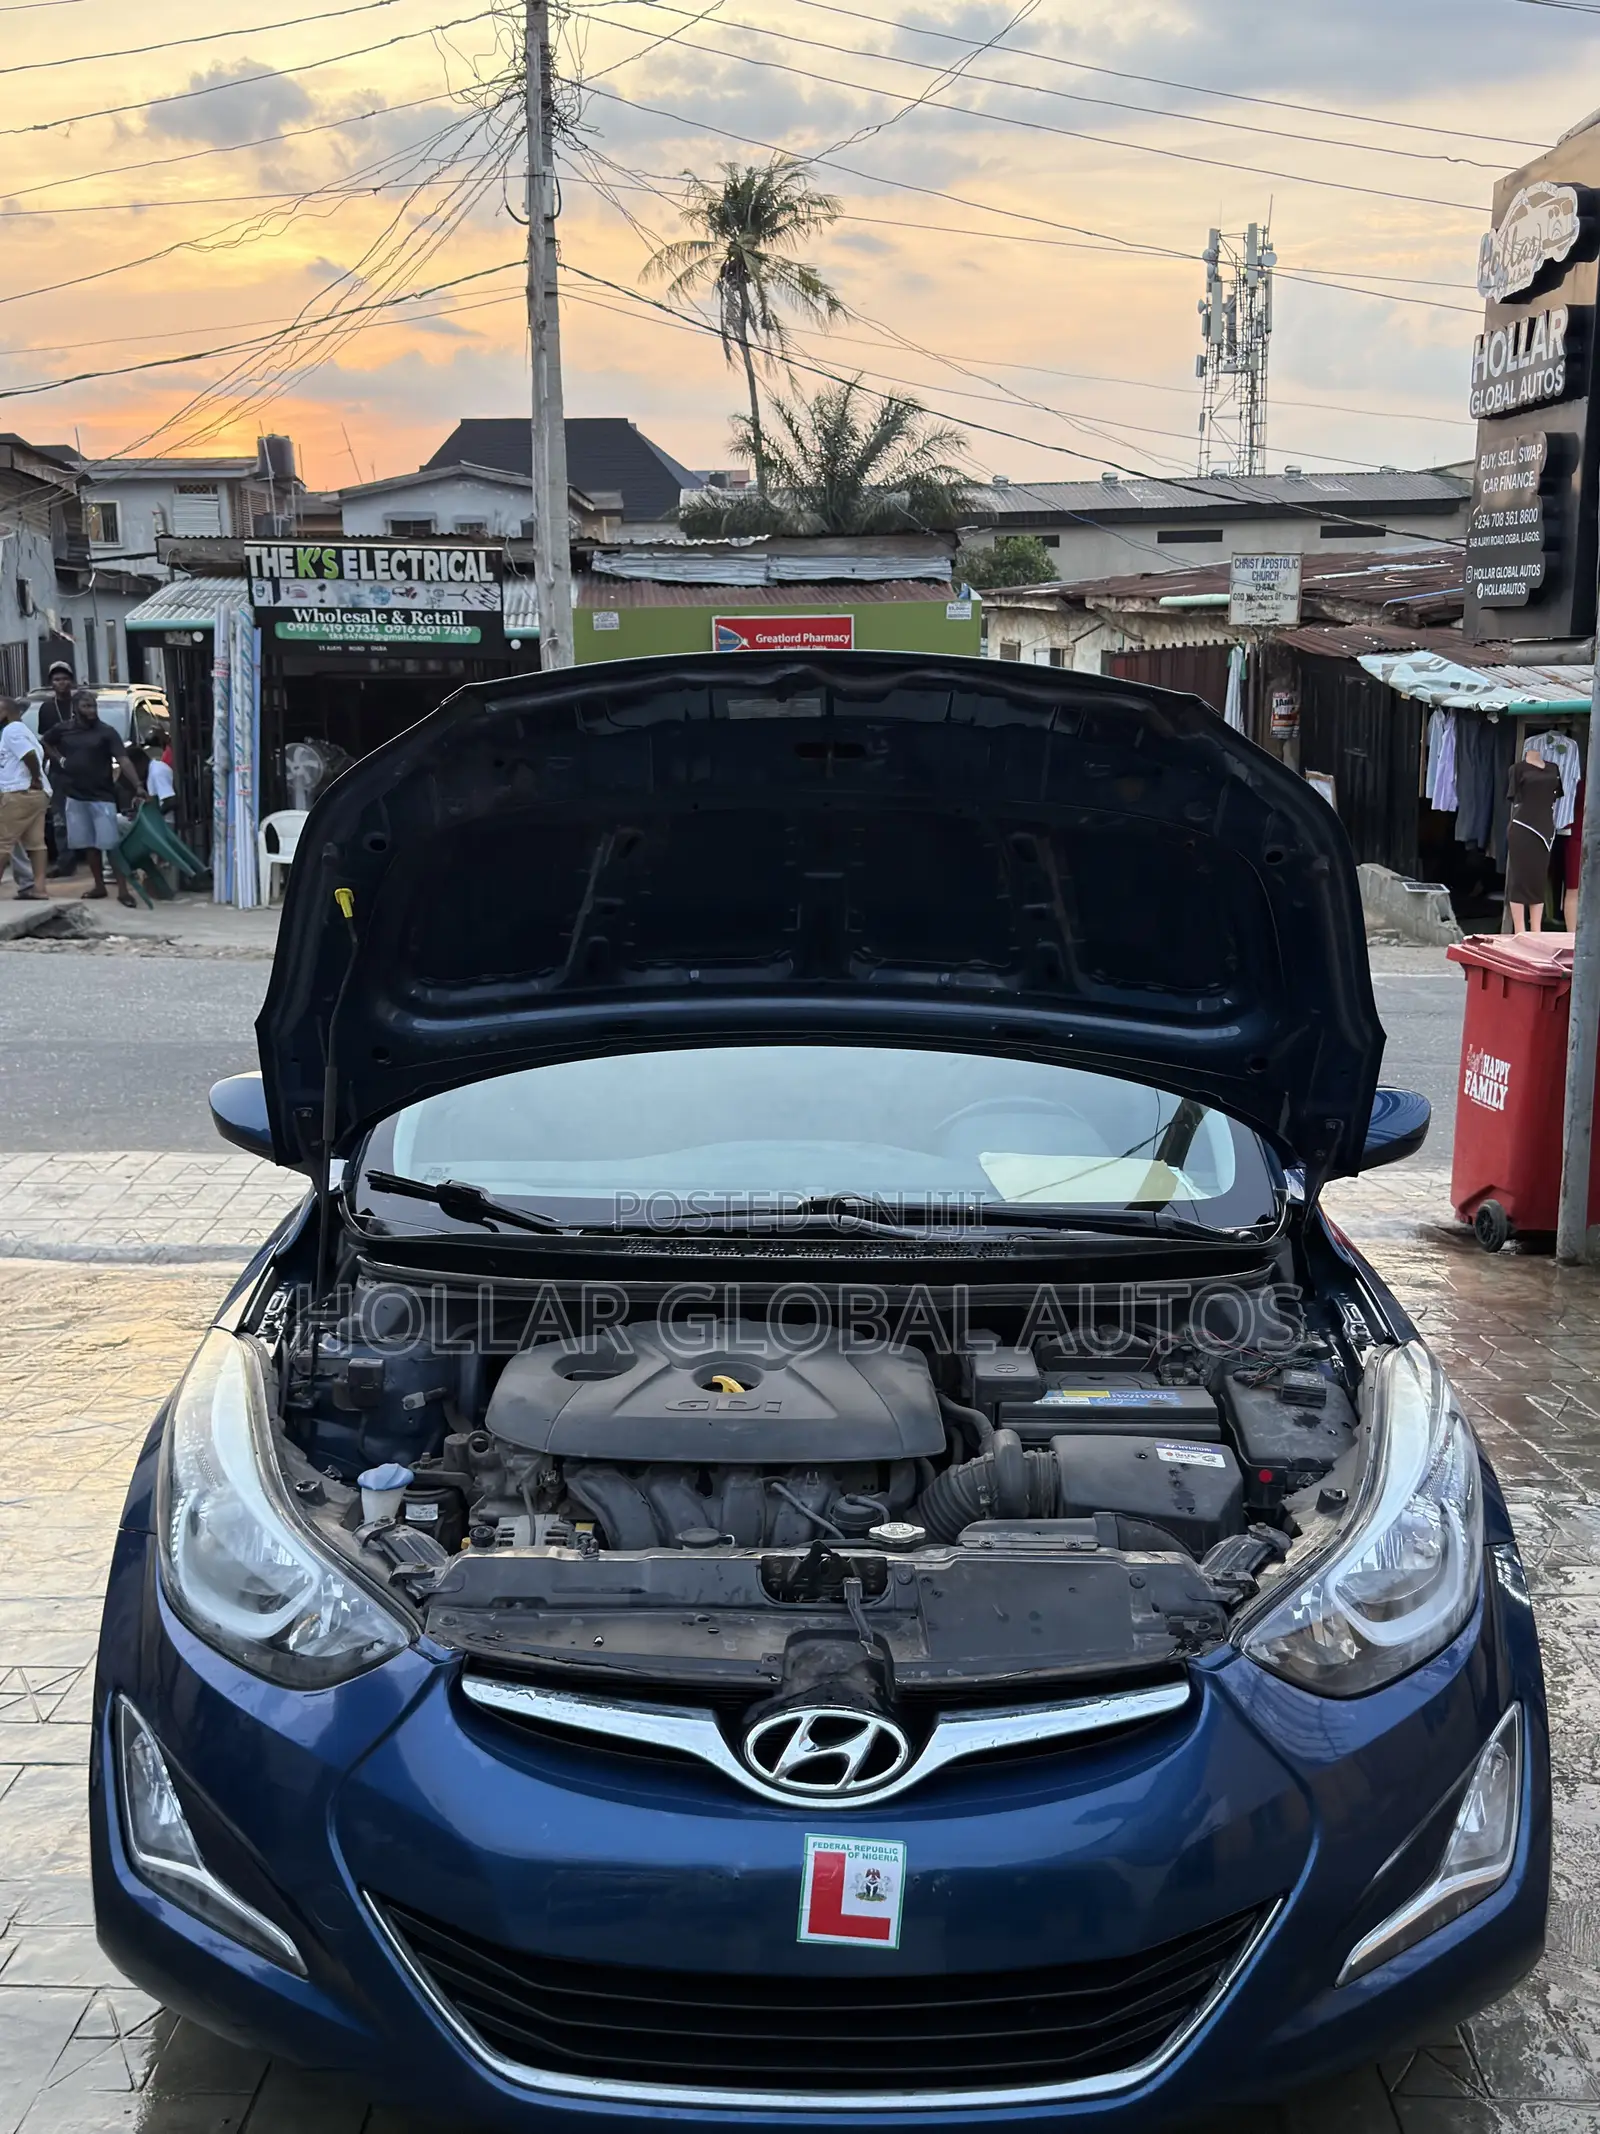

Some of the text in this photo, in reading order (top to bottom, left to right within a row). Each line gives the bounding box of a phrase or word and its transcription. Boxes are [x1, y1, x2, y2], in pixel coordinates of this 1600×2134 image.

[1473, 307, 1566, 384] HOLLAR
[1470, 365, 1564, 416] GLOBAL AUTOS
[1480, 452, 1496, 471] BUY,
[1497, 449, 1517, 467] SELL,
[1483, 476, 1499, 494] CAR
[1474, 514, 1490, 529] +234
[1504, 510, 1518, 526] 361
[1519, 507, 1538, 524] 8600
[343, 550, 494, 582] ELECTRICAL
[1234, 558, 1298, 569] CHRIST APOSTOLIC
[1473, 564, 1541, 580] HOLLAR GLOBAL AUTOS
[1252, 570, 1279, 581] CHURCH
[1484, 582, 1526, 596] HOLLARAUTOS
[293, 608, 464, 625] Wholesale & Retail
[287, 622, 318, 632] 0916
[384, 624, 416, 634] 0916
[418, 625, 441, 635] 601
[443, 626, 472, 636] 7419
[755, 632, 850, 644] Greatlord Pharmacy
[1482, 1054, 1511, 1085] HAPPY
[1464, 1069, 1508, 1111] FAMILY
[812, 1842, 898, 1855] FEDERAL REPUBLIC
[848, 1851, 899, 1863] OF NIGERIA
[808, 1851, 891, 1940] L
